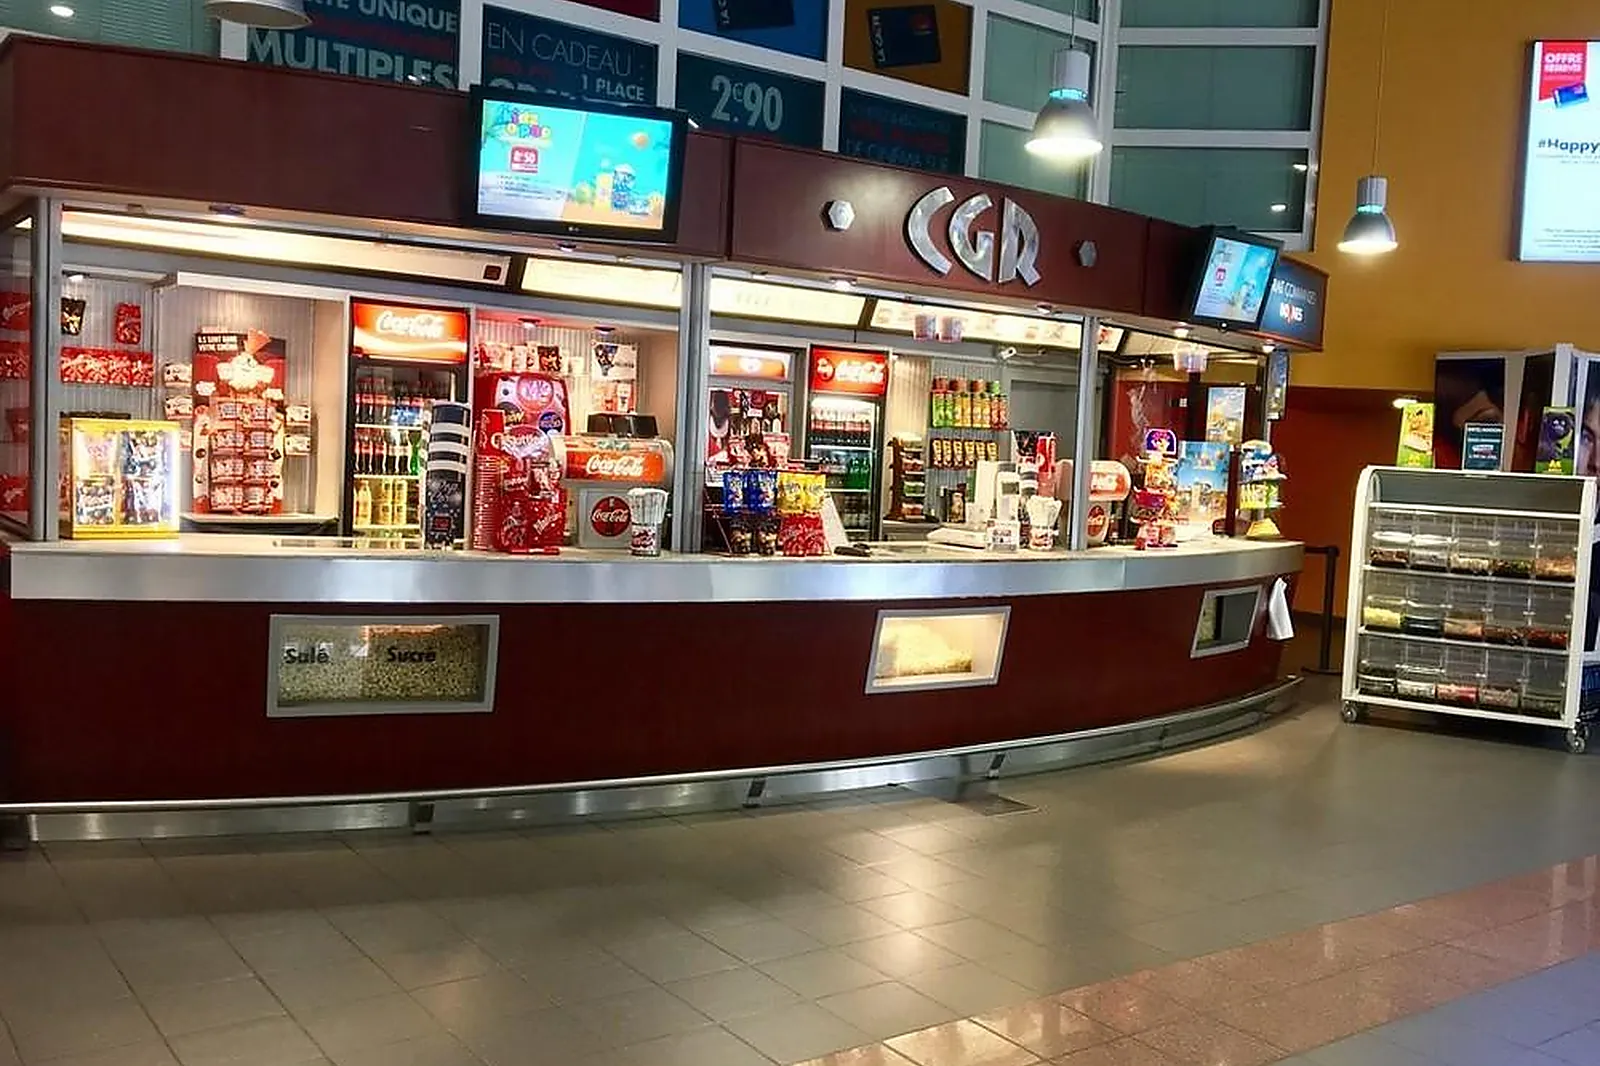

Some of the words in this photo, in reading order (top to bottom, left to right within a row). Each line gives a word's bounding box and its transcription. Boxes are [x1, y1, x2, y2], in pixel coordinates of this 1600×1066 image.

[357, 0, 459, 33] UNIQUE
[248, 27, 456, 89] MULTIPLES
[487, 22, 525, 54] EN
[531, 33, 632, 77] CADEAU
[1544, 52, 1584, 65] OFFRE
[581, 74, 588, 90] 1
[595, 78, 645, 101] PLACE
[908, 186, 1041, 286] CGR
[586, 454, 644, 477] Coca-Cola
[284, 645, 330, 664] Salé
[386, 646, 437, 663] Sucré
